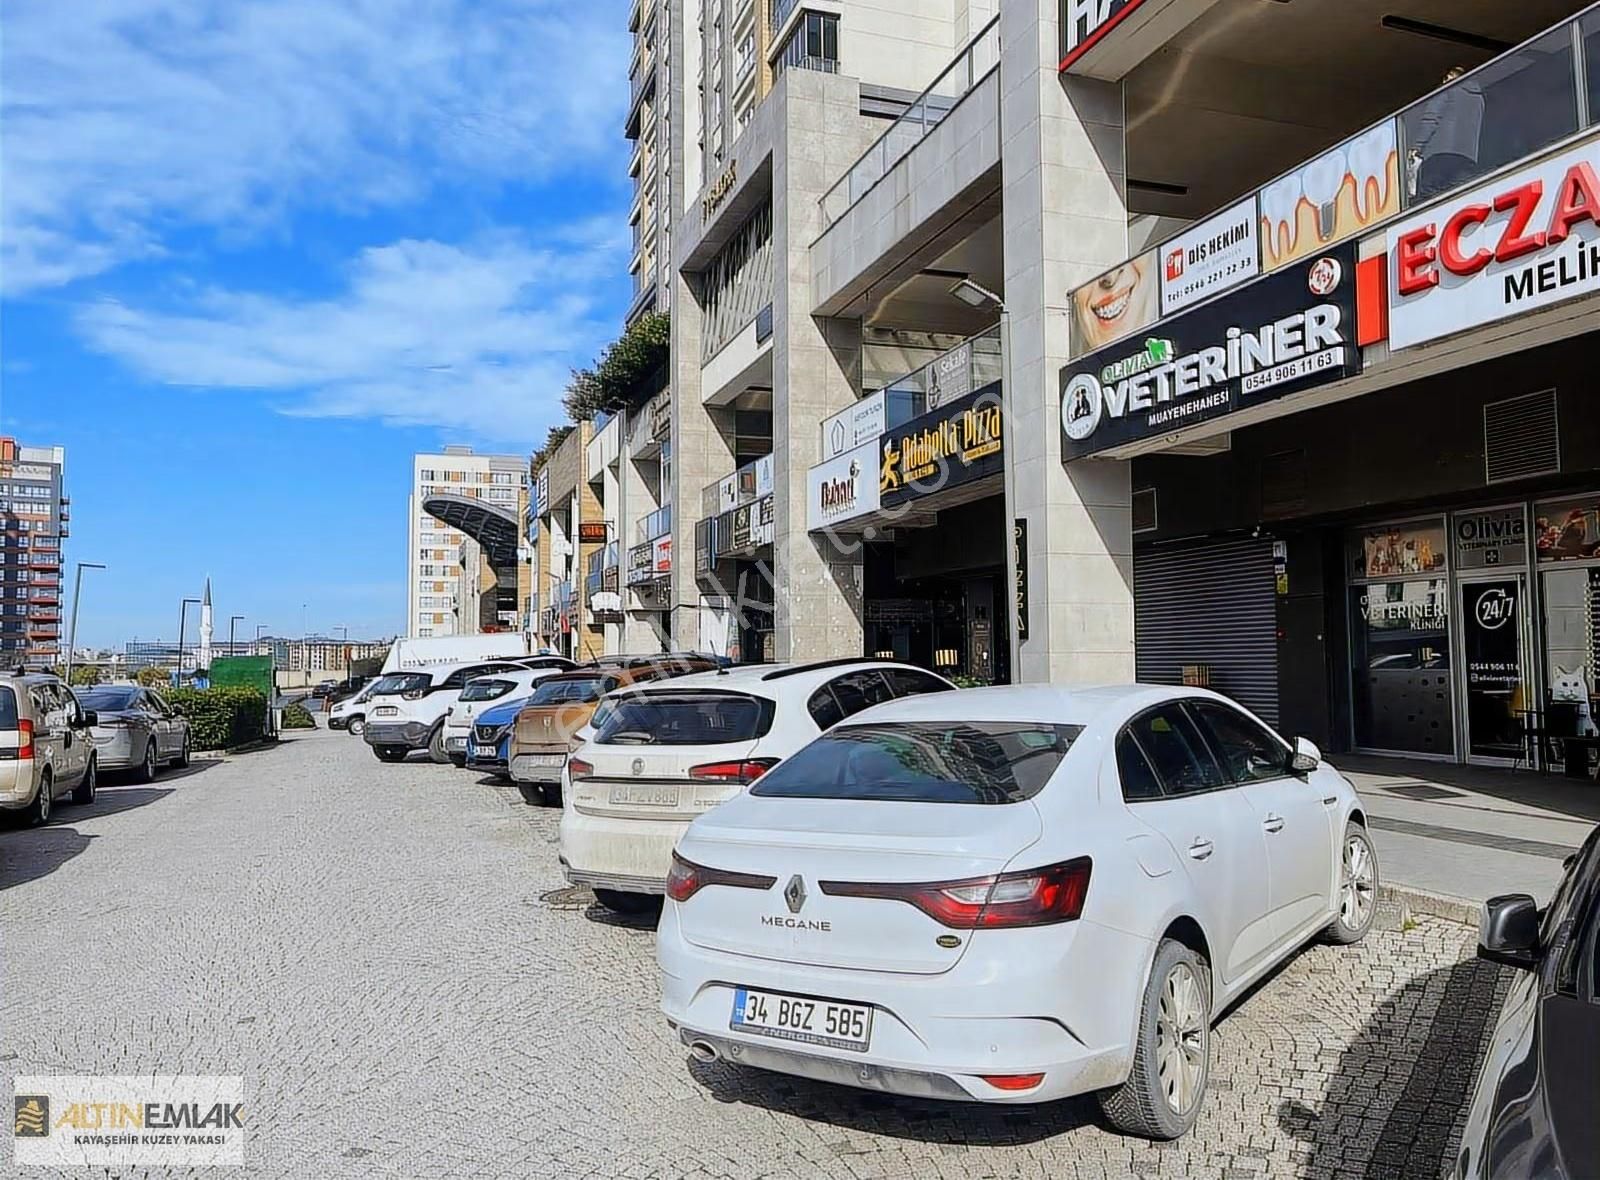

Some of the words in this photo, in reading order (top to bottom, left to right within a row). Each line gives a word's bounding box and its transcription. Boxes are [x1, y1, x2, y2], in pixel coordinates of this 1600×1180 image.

[1188, 241, 1207, 266] DİŞ
[1209, 218, 1249, 256] HEKİMİ
[1397, 160, 1600, 296] ECZA
[1208, 271, 1223, 285] 221
[1227, 264, 1236, 276] 22
[1241, 257, 1251, 270] 33
[1102, 304, 1345, 419] VETERİNER
[1246, 372, 1272, 391] 0544
[1275, 365, 1297, 382] 906
[1300, 360, 1313, 375] 11
[1317, 352, 1332, 368] 63
[964, 406, 1000, 449] Pizza
[1458, 514, 1525, 541] Olivia
[1482, 597, 1514, 621] 24/7
[761, 916, 832, 932] MEGANE
[746, 996, 768, 1024] 34
[778, 999, 815, 1031] BGZ
[826, 1006, 865, 1038] 585
